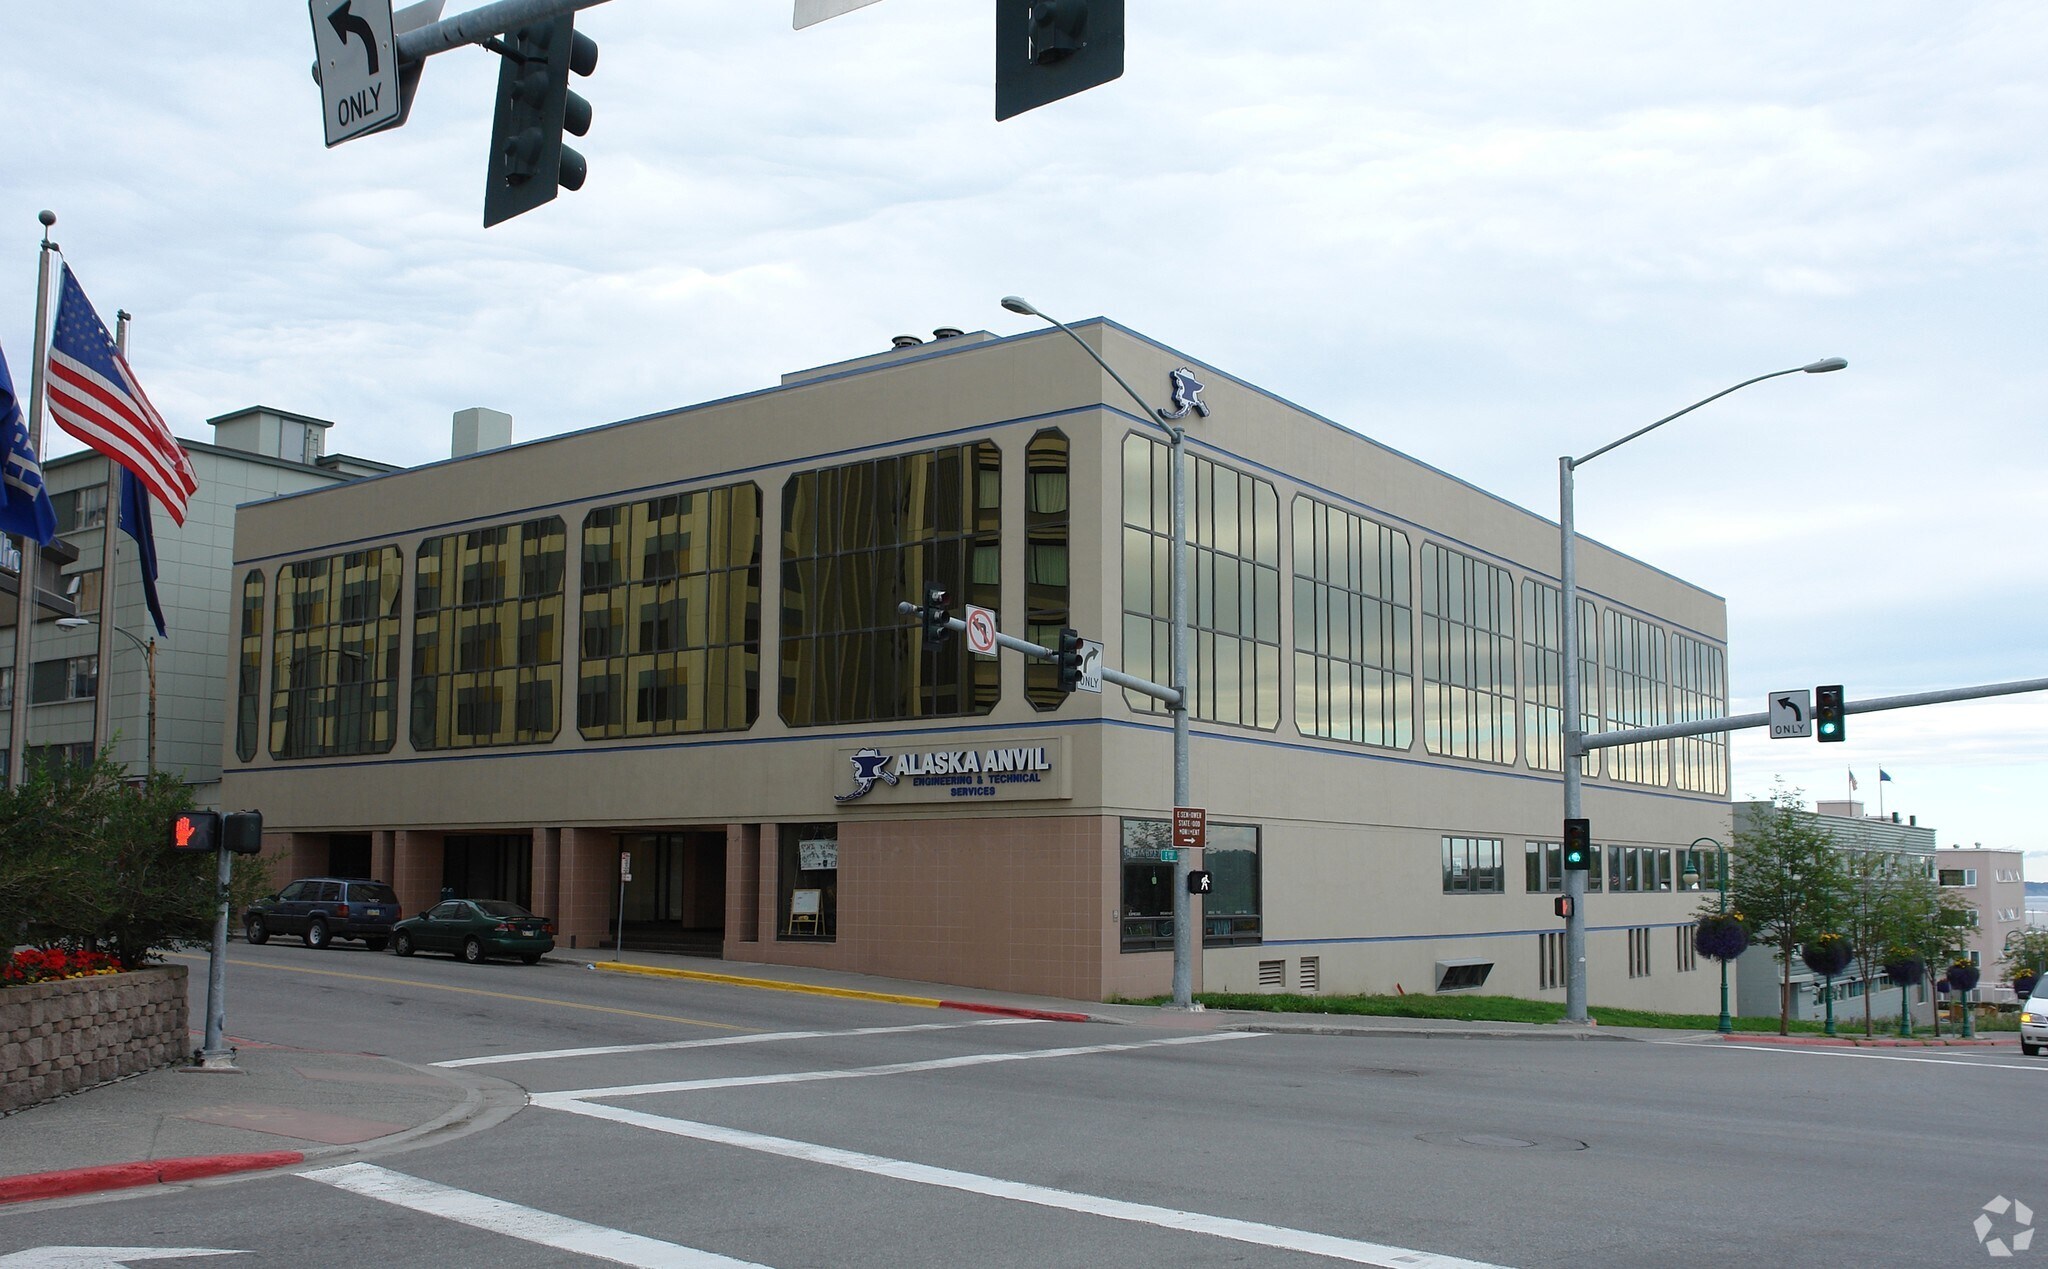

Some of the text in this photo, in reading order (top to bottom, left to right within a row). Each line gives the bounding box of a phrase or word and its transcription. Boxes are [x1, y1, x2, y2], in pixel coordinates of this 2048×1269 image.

[338, 82, 382, 126] ONLY
[1775, 724, 1805, 735] ONLY
[894, 747, 1051, 776] ALASKA ANVIL
[913, 772, 1042, 787] ENGINEERING & TECHNICAL
[950, 785, 996, 797] SERVICES
